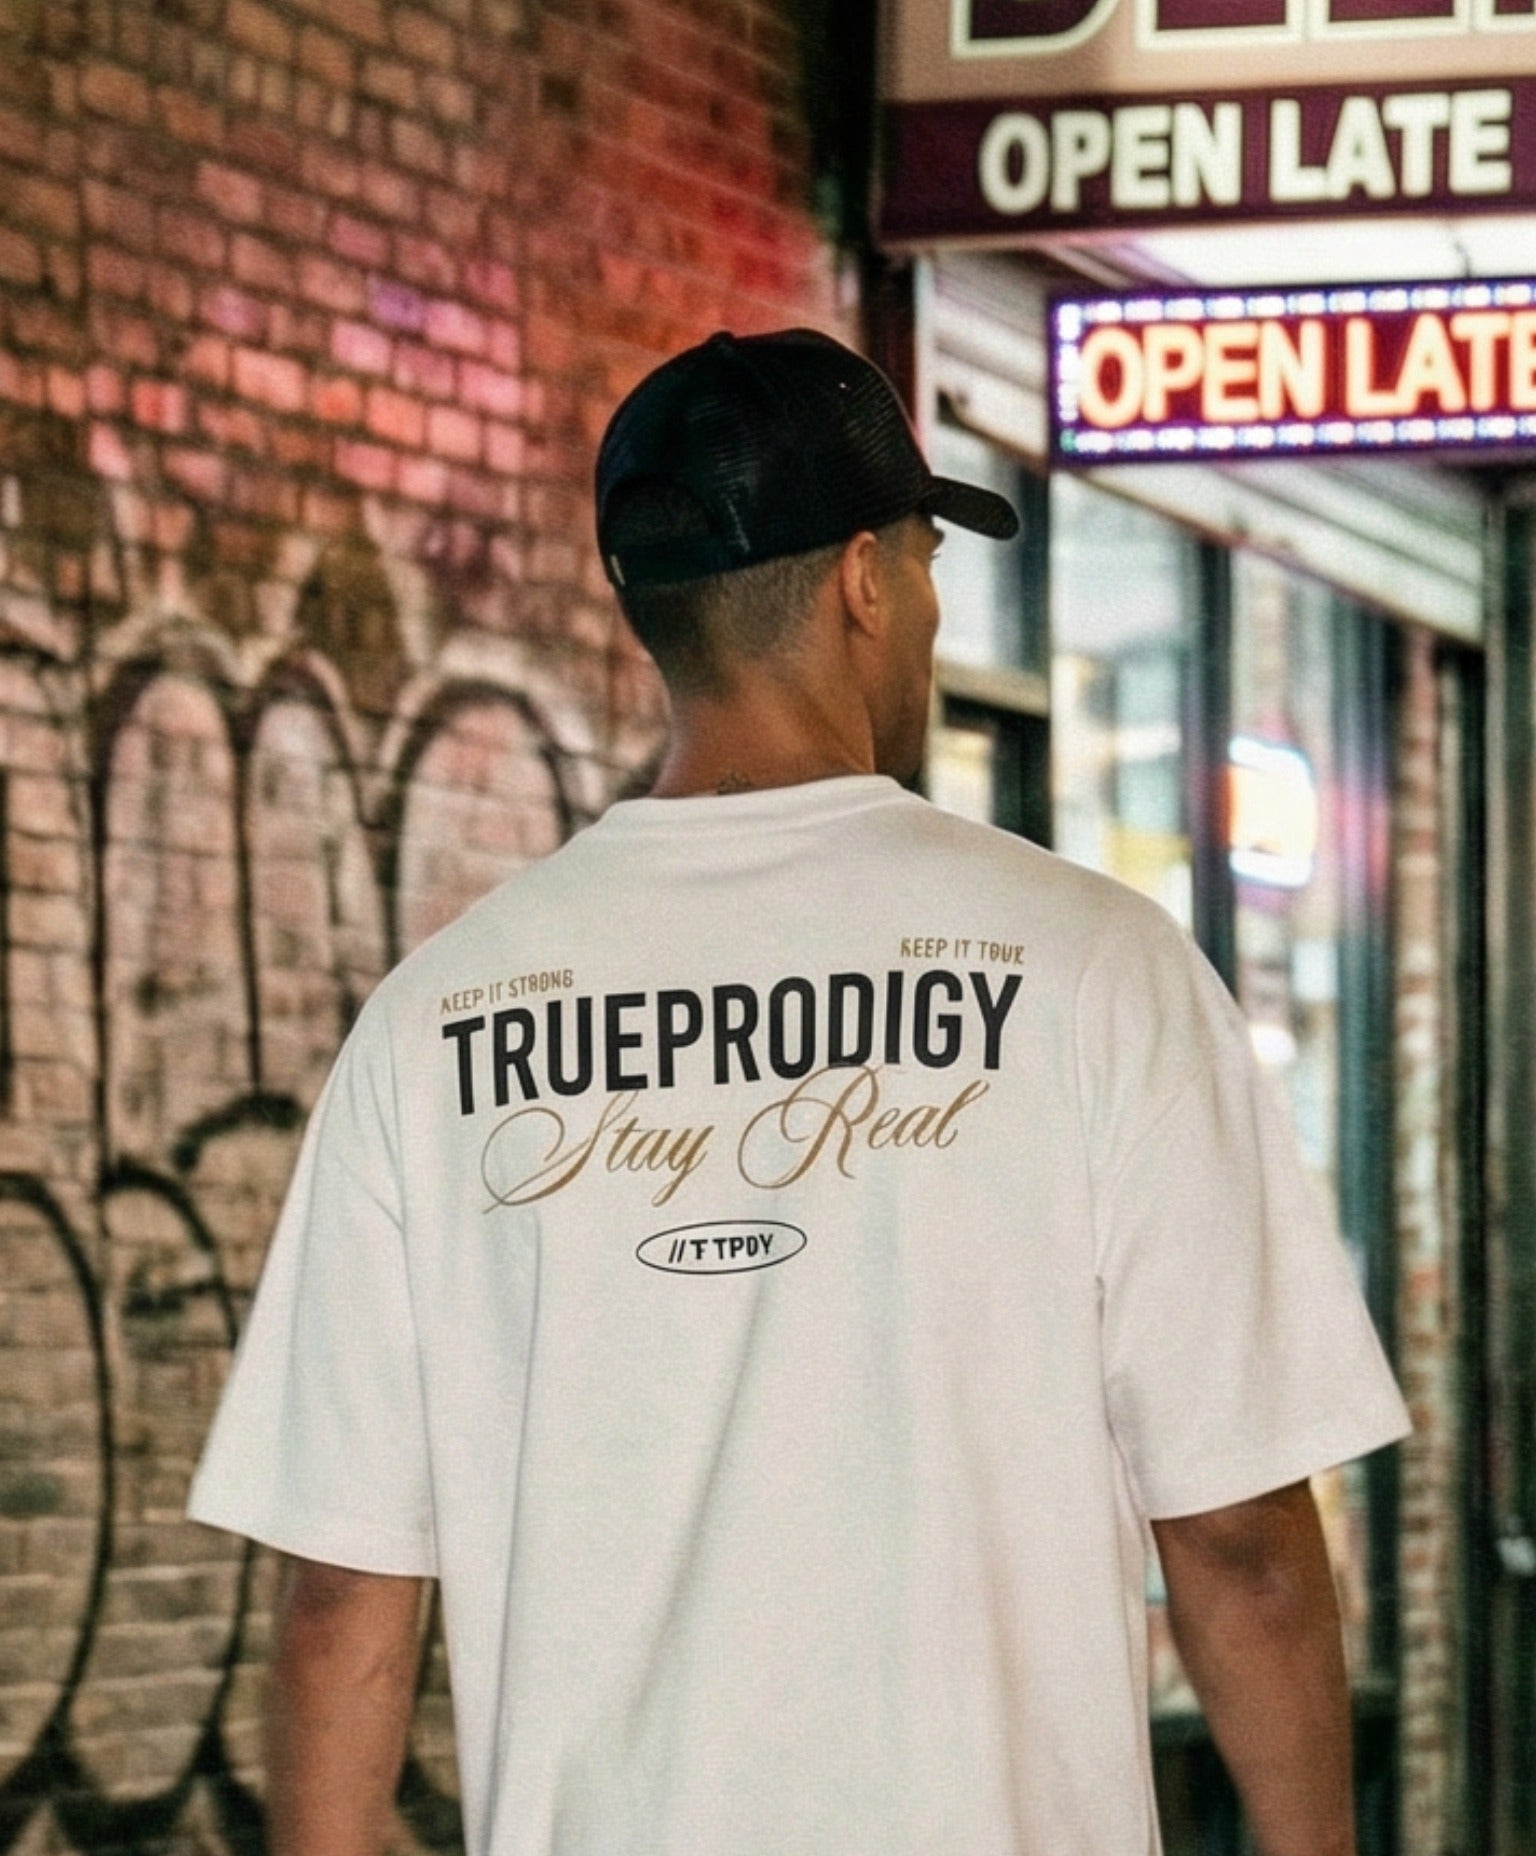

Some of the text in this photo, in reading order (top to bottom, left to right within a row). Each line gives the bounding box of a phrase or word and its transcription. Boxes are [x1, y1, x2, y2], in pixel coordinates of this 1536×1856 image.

[978, 101, 1243, 215] OPEN
[1270, 88, 1513, 202] LATE
[1078, 317, 1325, 428] OPEN
[954, 939, 971, 958] IT
[442, 969, 1024, 1117] TRUEPRODIGY
[480, 1063, 991, 1214] Stay Real
[712, 1233, 774, 1261] TPDY
